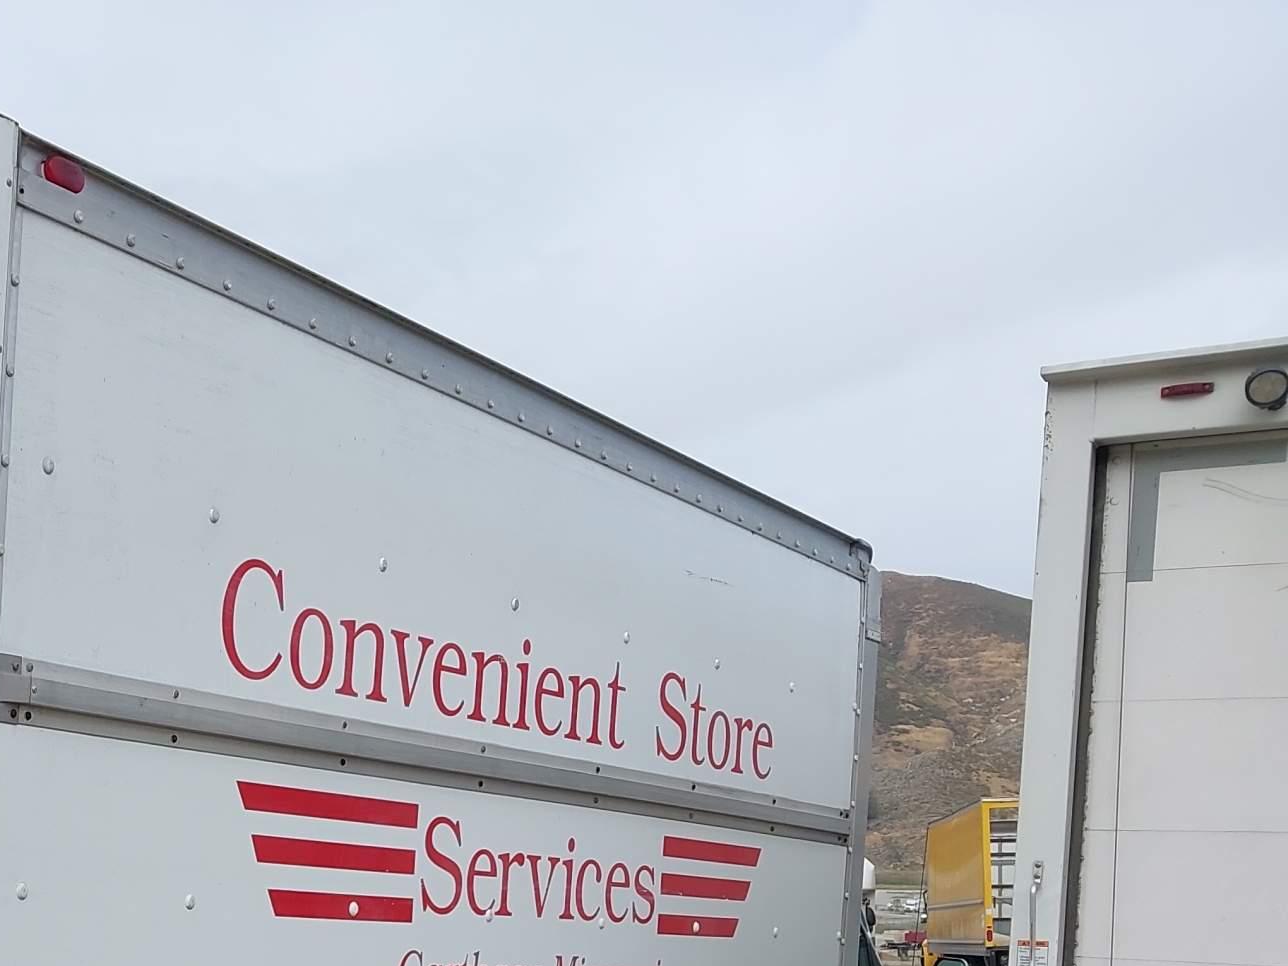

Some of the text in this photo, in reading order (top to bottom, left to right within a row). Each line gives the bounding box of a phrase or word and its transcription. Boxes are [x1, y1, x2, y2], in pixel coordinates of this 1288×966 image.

[220, 557, 774, 780] Convenient Store
[419, 815, 657, 926] Services
